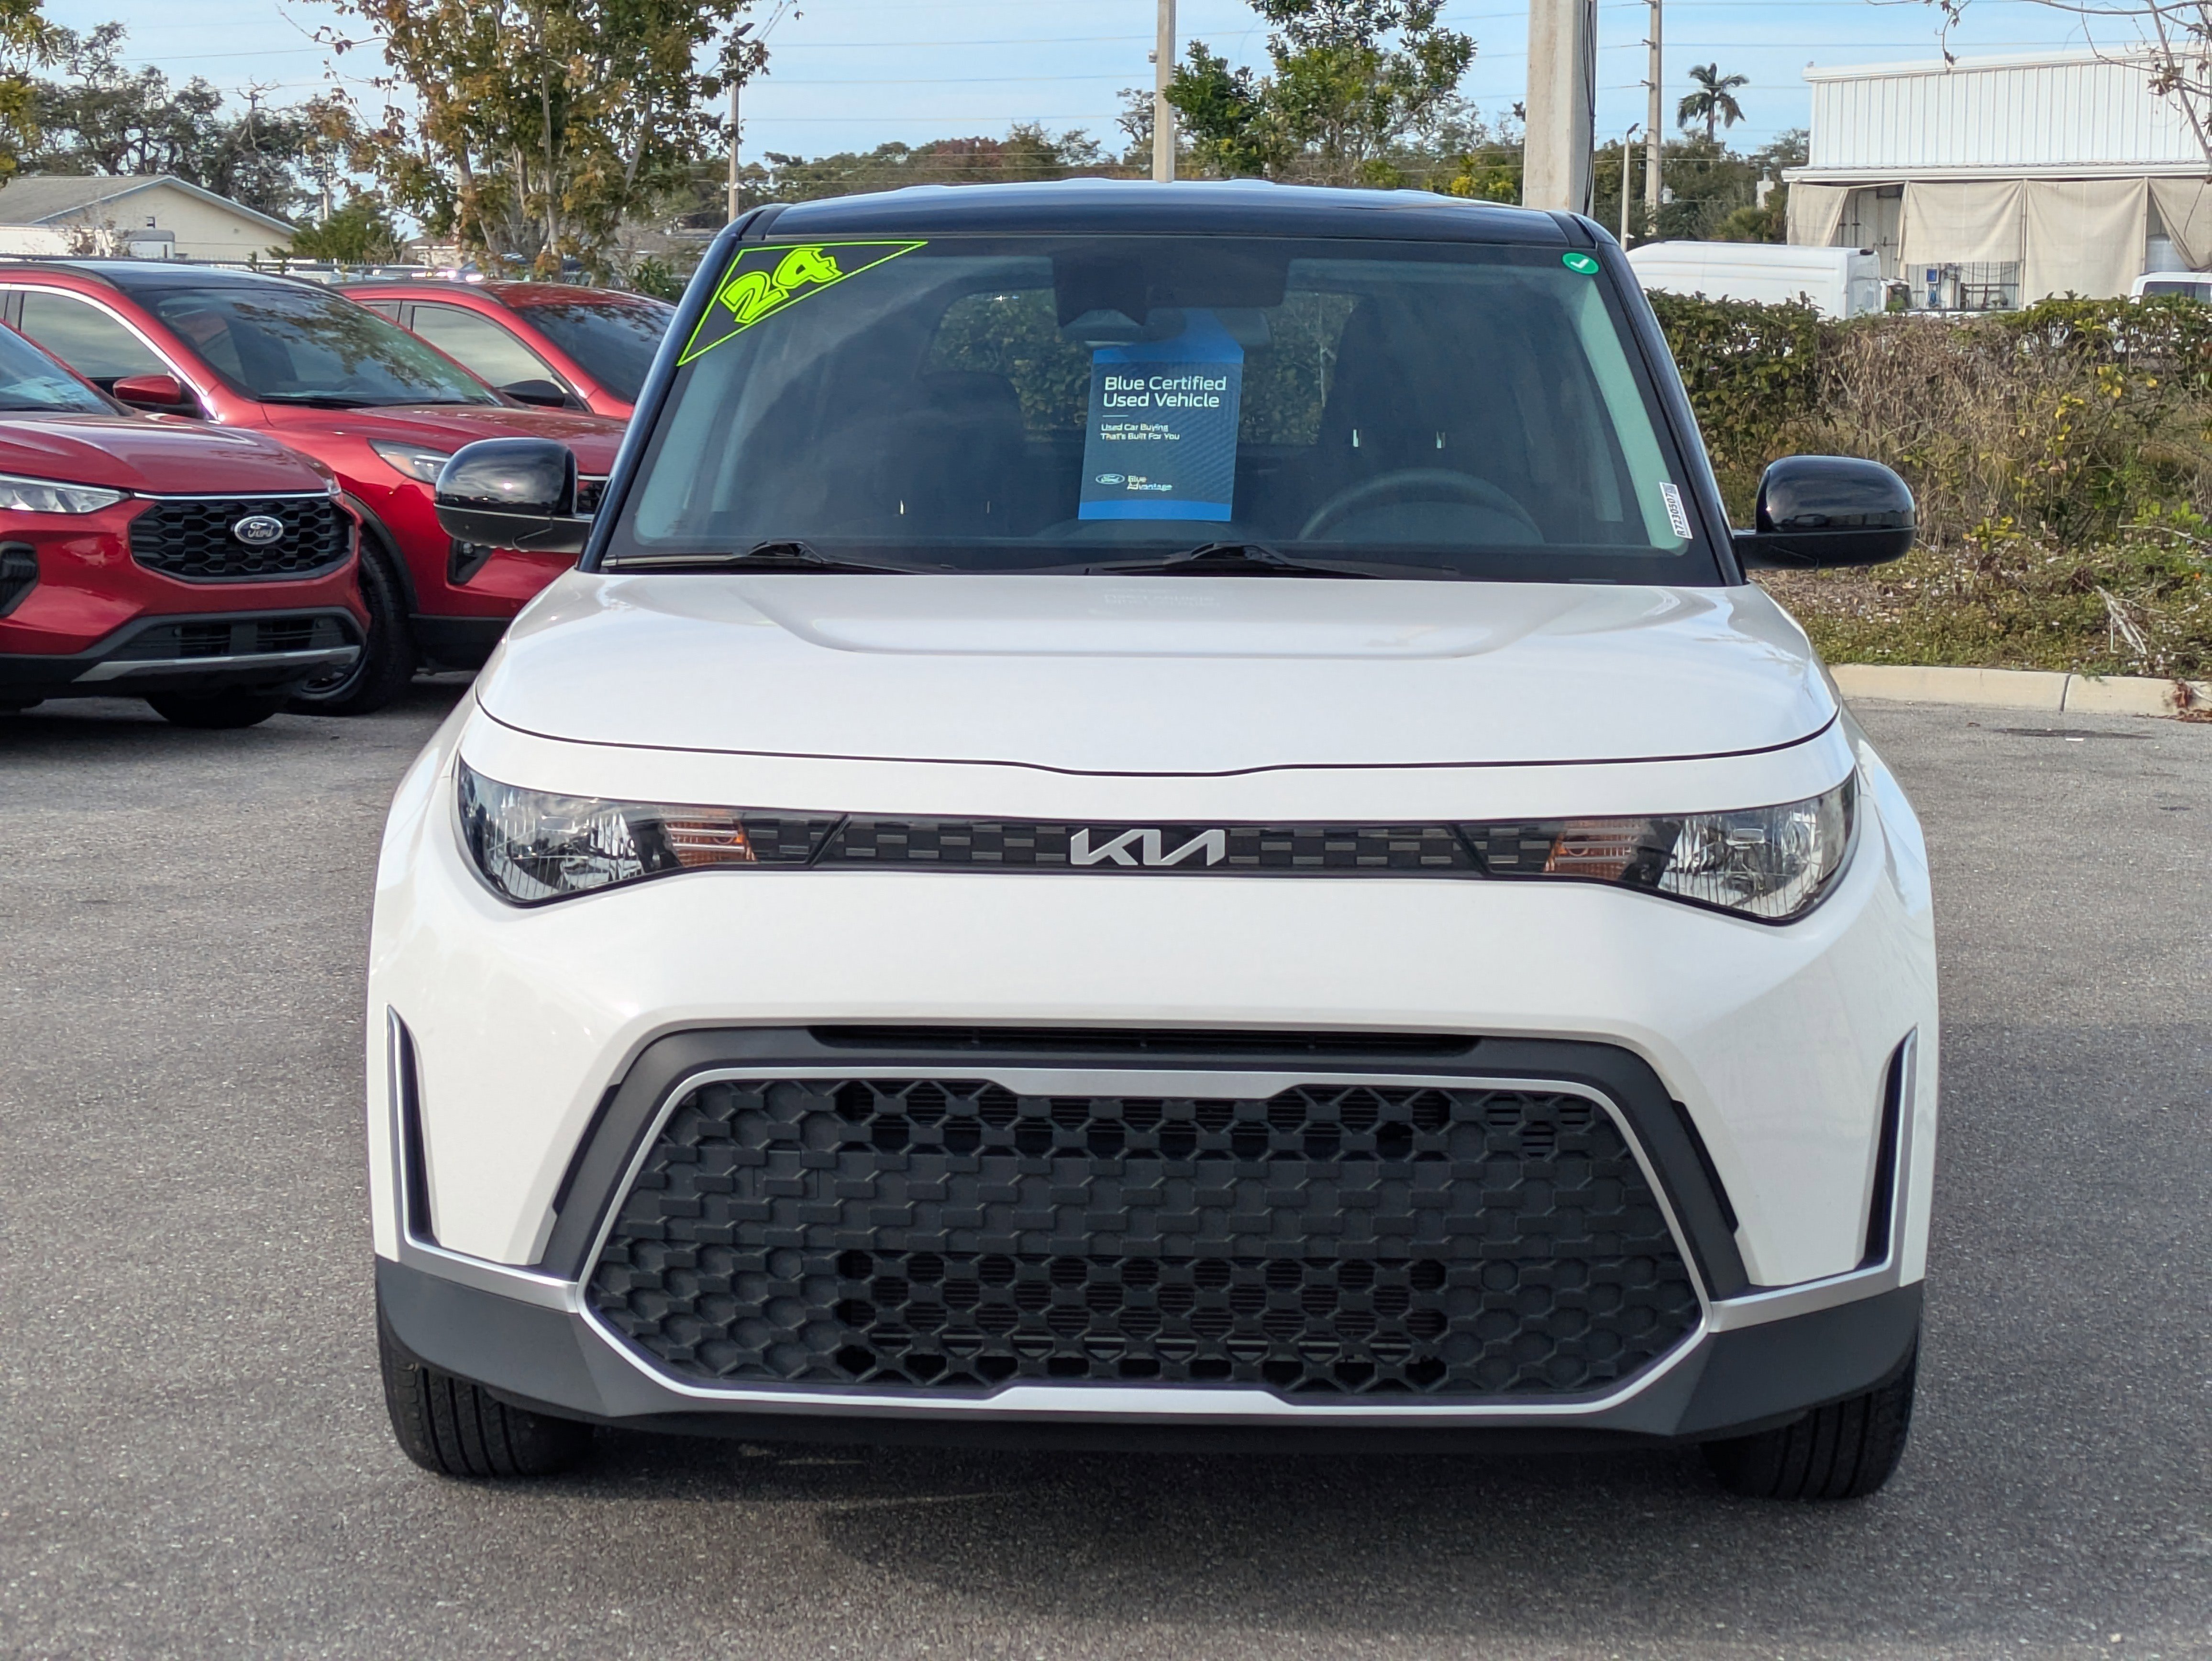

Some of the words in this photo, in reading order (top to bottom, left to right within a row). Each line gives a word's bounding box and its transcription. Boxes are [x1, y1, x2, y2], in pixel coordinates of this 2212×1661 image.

[719, 247, 843, 324] 24
[1105, 376, 1145, 390] Blue
[1149, 376, 1227, 391] Certified
[1103, 392, 1150, 407] Used
[1154, 392, 1219, 408] Vehicle
[1101, 423, 1123, 431] Used
[1140, 423, 1168, 432] Buying
[248, 522, 274, 537] Ford
[1070, 828, 1225, 866] KIA
